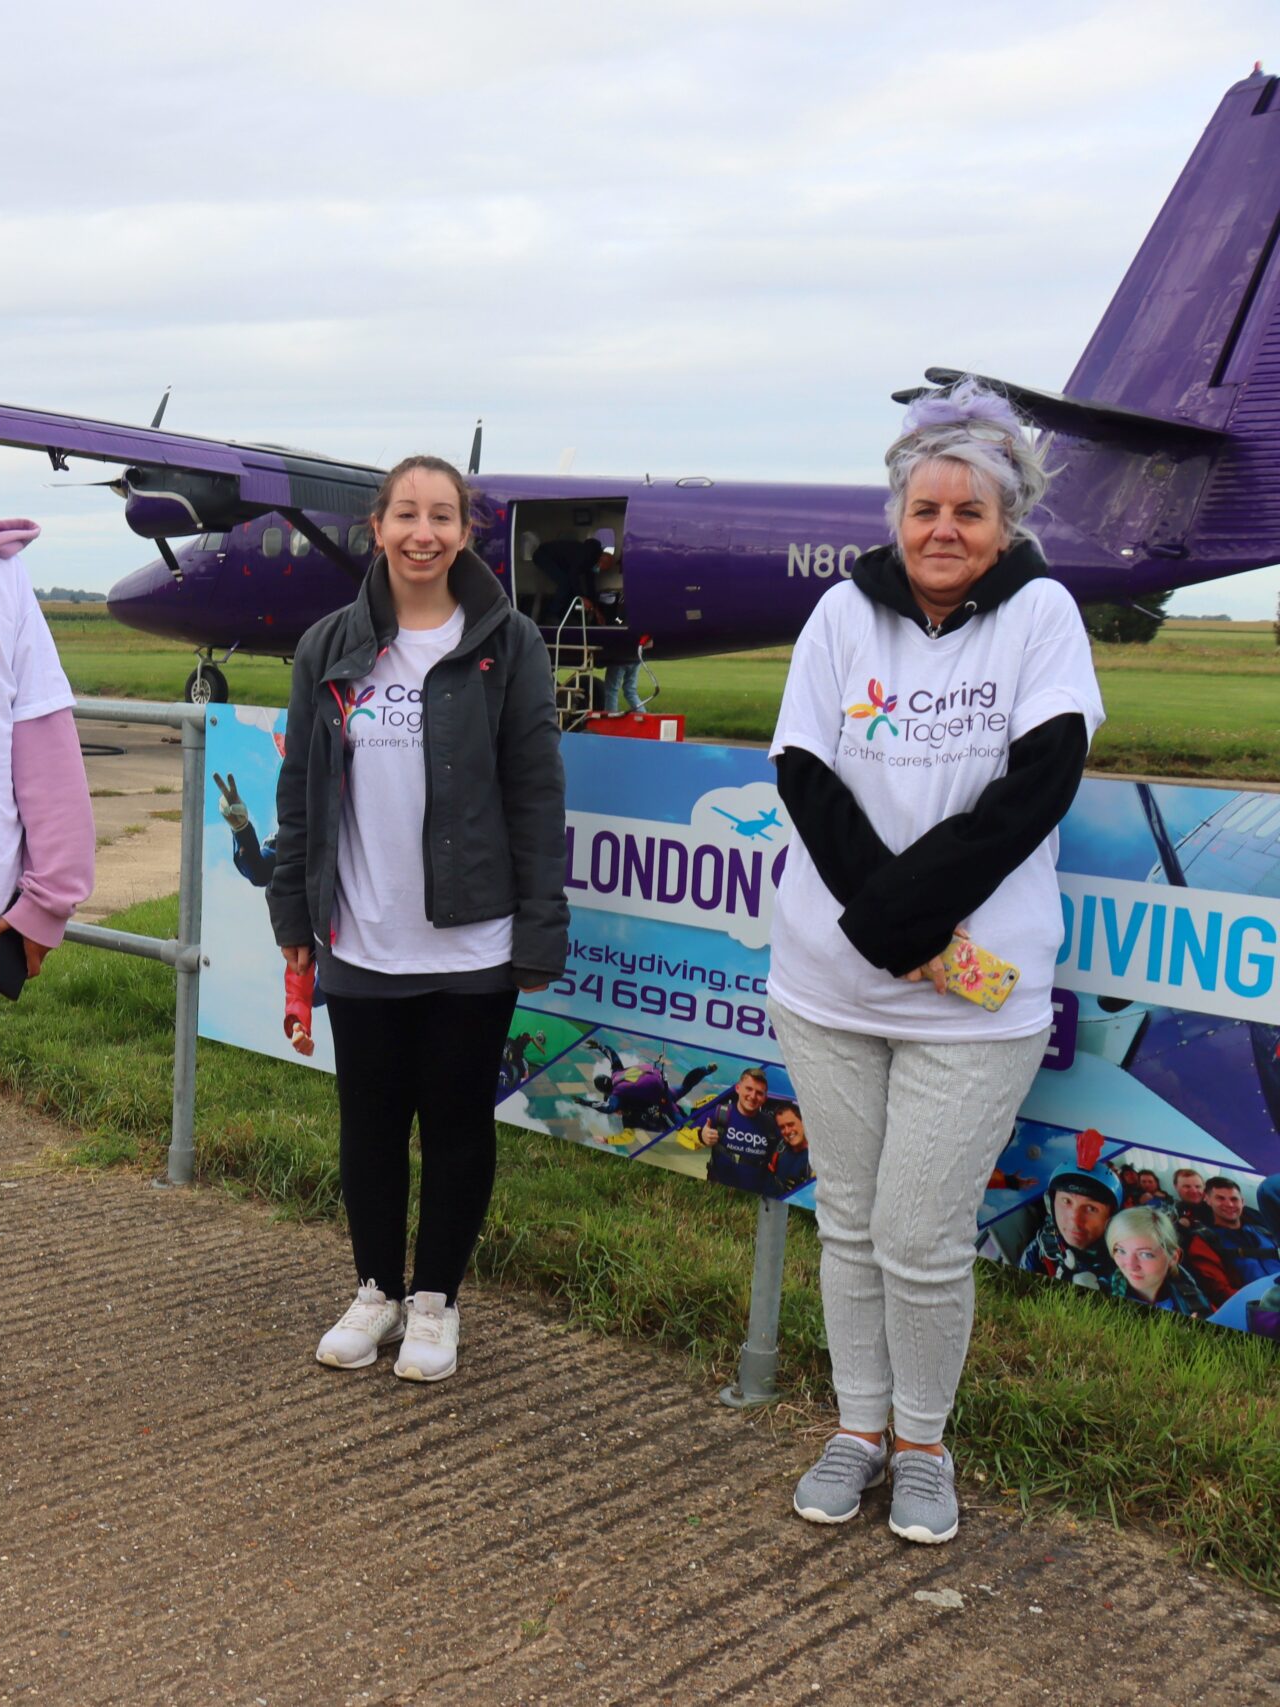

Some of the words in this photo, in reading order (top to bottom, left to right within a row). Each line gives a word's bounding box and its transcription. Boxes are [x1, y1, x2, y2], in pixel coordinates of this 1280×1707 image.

[787, 543, 883, 578] N80
[368, 738, 409, 748] carers
[899, 711, 1007, 749] Togethe
[564, 826, 763, 918] LONDON
[611, 978, 697, 1022] 699
[726, 1126, 768, 1148] Scope
